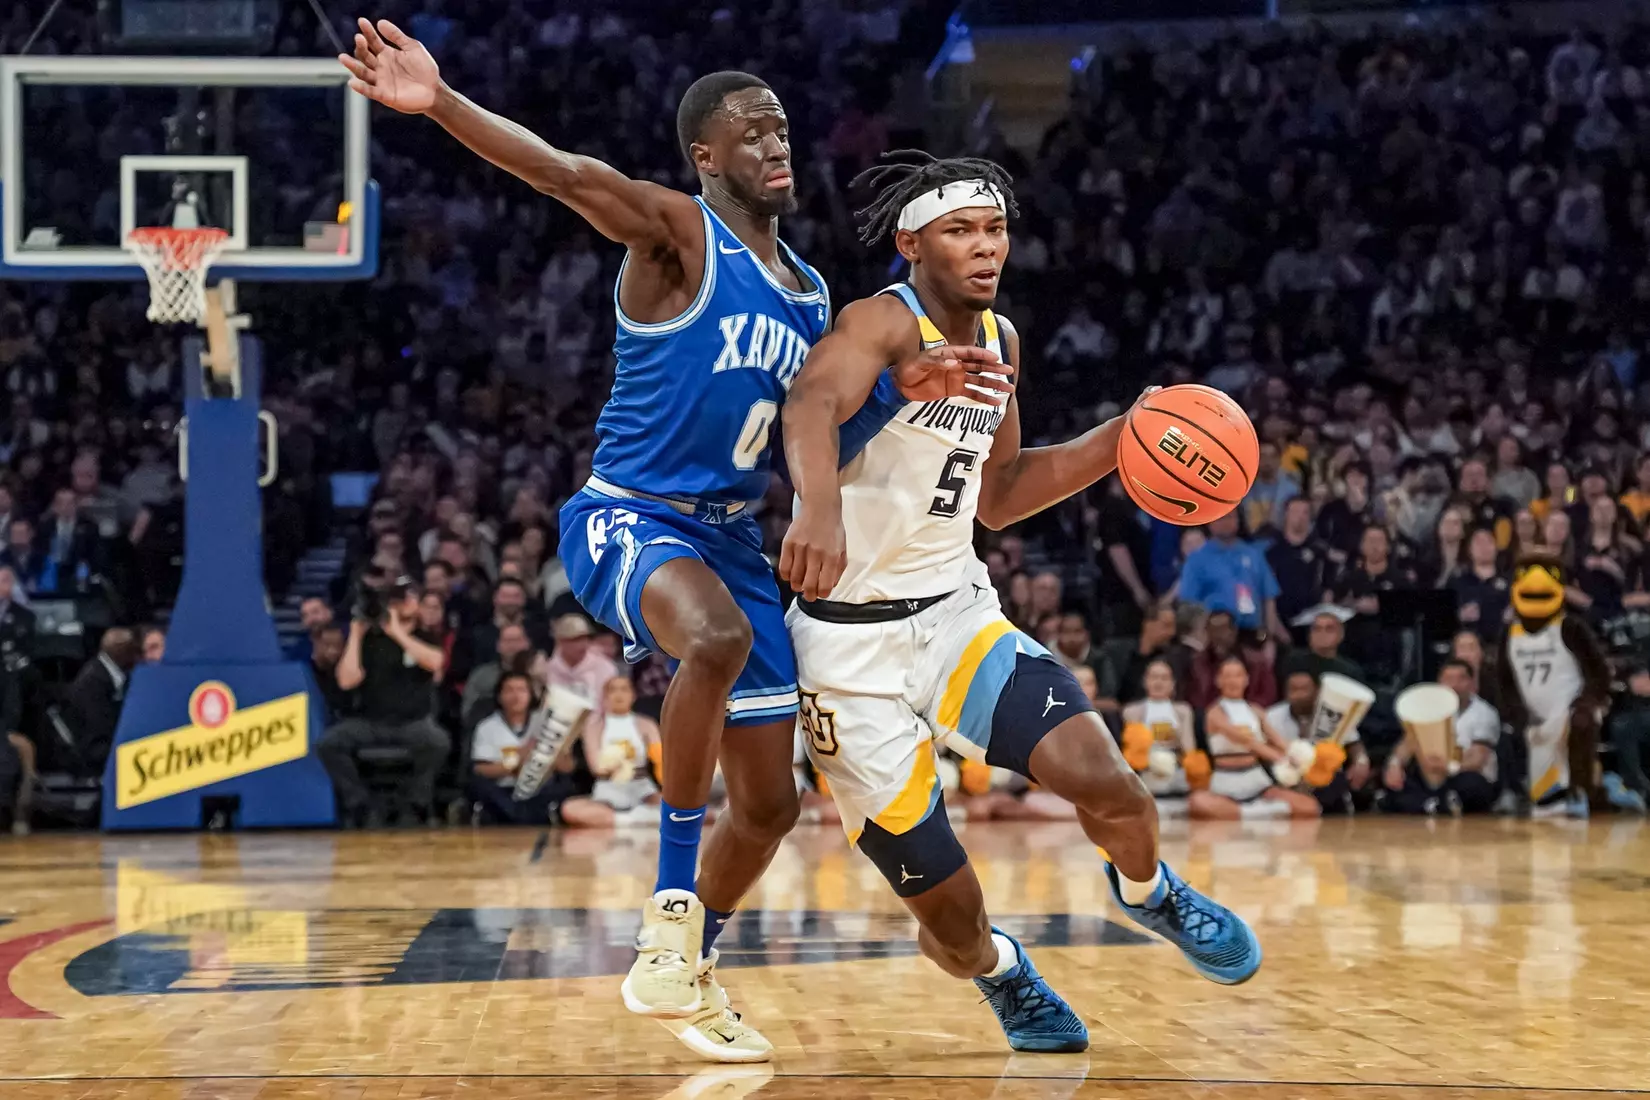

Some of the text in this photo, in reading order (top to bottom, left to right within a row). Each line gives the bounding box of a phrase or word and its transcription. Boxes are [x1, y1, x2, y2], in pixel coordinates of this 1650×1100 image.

[712, 313, 811, 391] XAVIE
[732, 398, 777, 471] 0
[1156, 429, 1228, 490] ELITE
[927, 448, 979, 518] 5
[1524, 661, 1552, 685] 77
[129, 712, 297, 797] Schweppes
